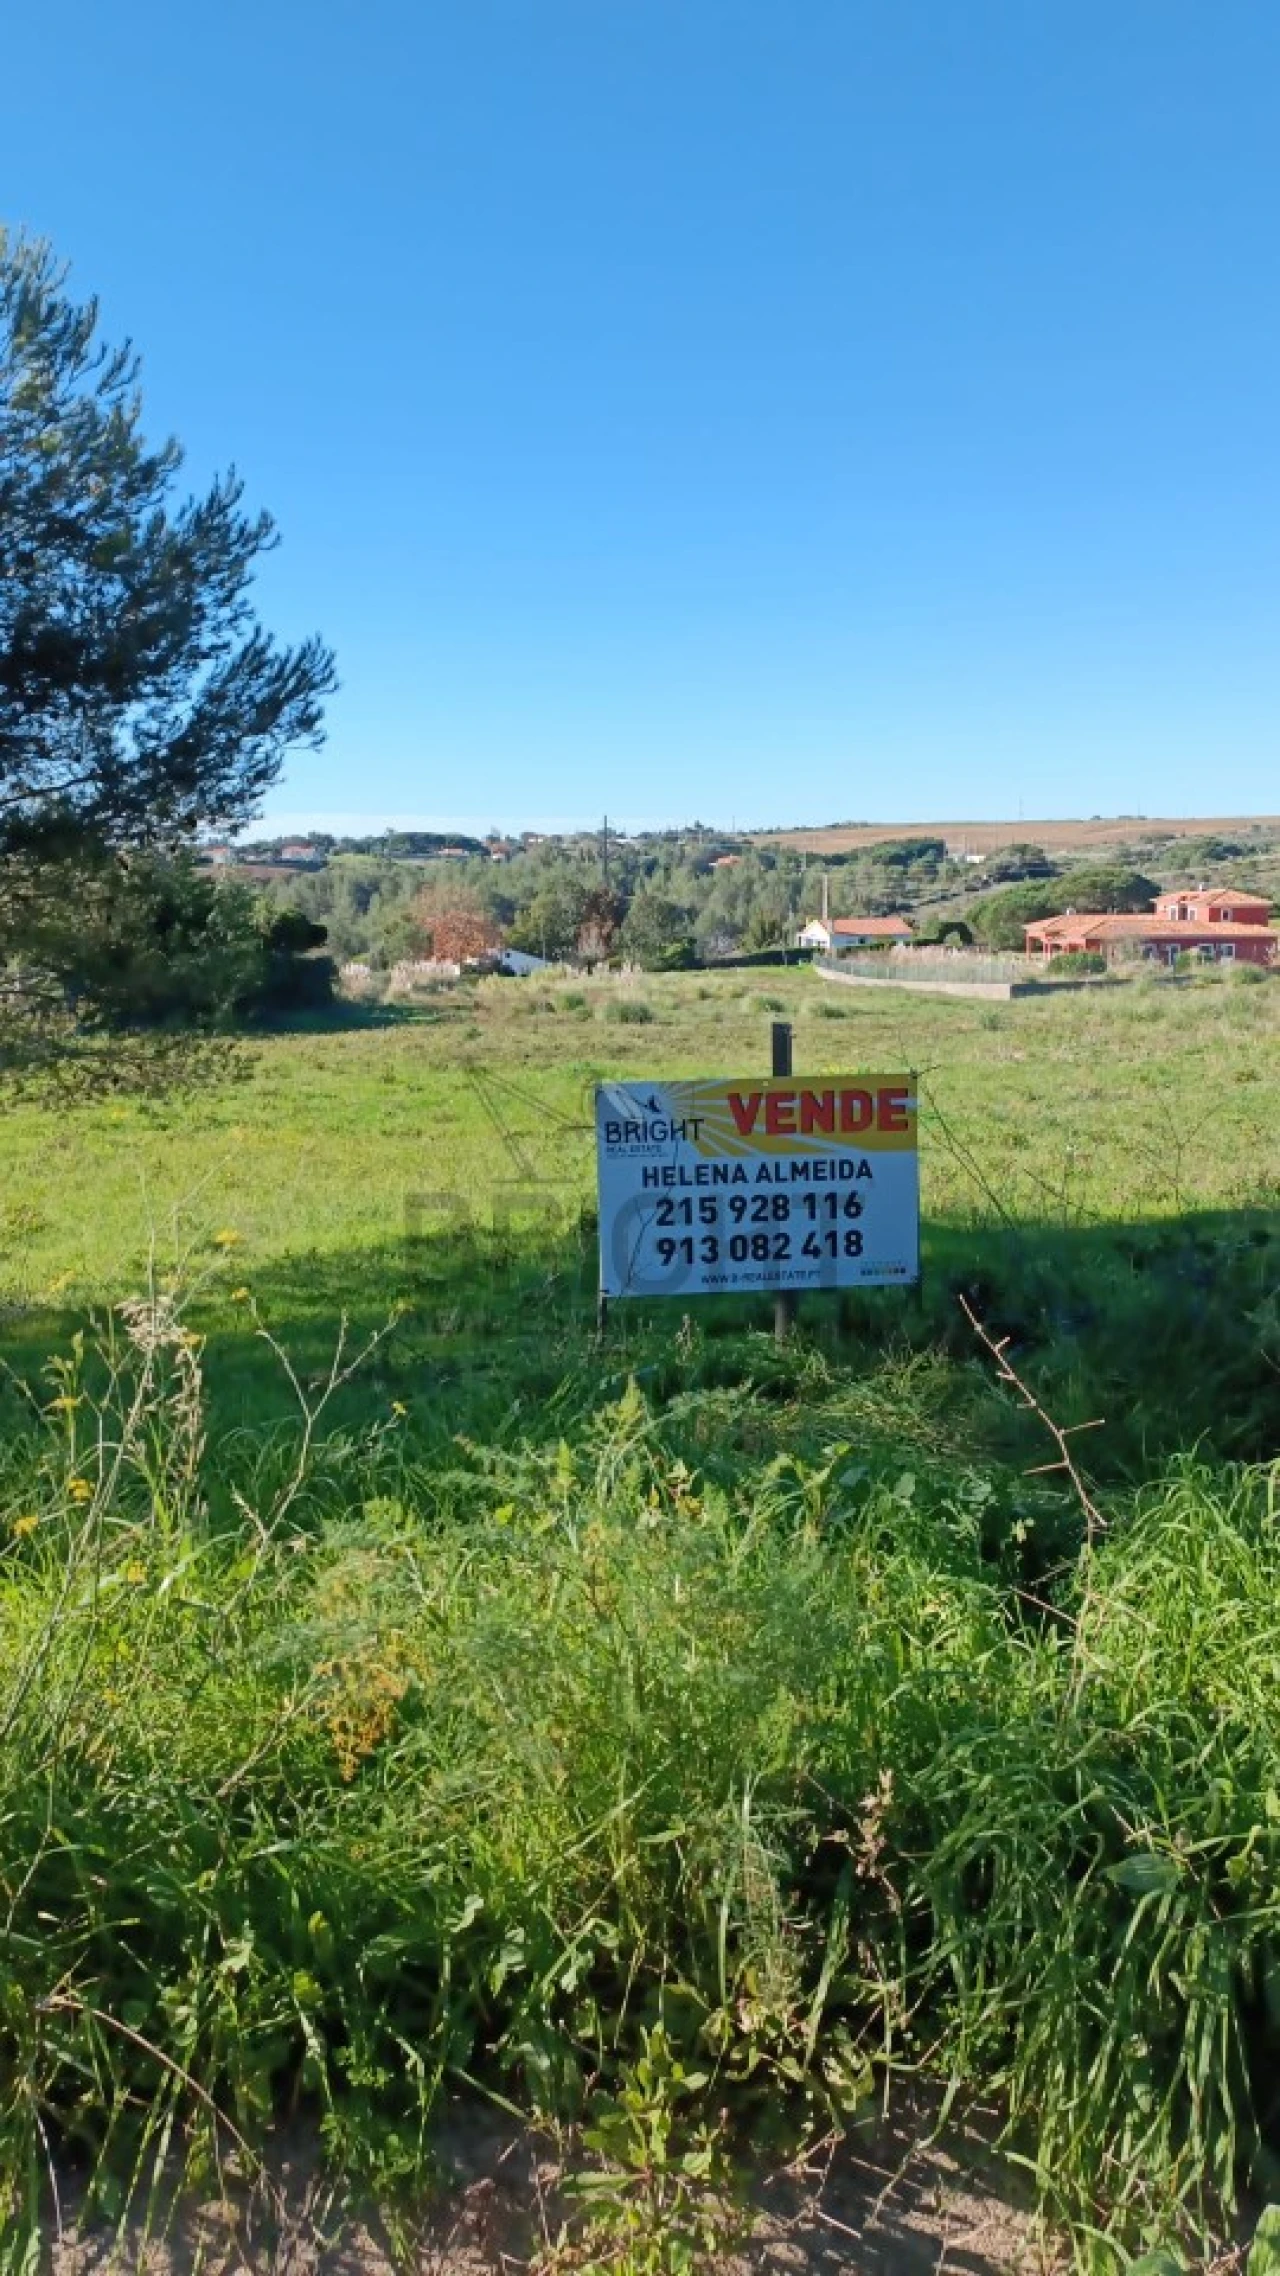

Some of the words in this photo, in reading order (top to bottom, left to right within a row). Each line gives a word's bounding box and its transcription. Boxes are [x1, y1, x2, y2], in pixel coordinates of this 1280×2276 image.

[728, 1087, 909, 1136] VENDE
[605, 1118, 704, 1144] BRIGHT
[642, 1162, 749, 1188] HELENA
[756, 1158, 873, 1184] ALMEIDA
[656, 1195, 718, 1227] 215
[729, 1193, 790, 1223] 928
[803, 1190, 863, 1221] 116
[656, 1236, 719, 1266] 913
[729, 1232, 791, 1262] 082
[801, 1229, 864, 1259] 418
